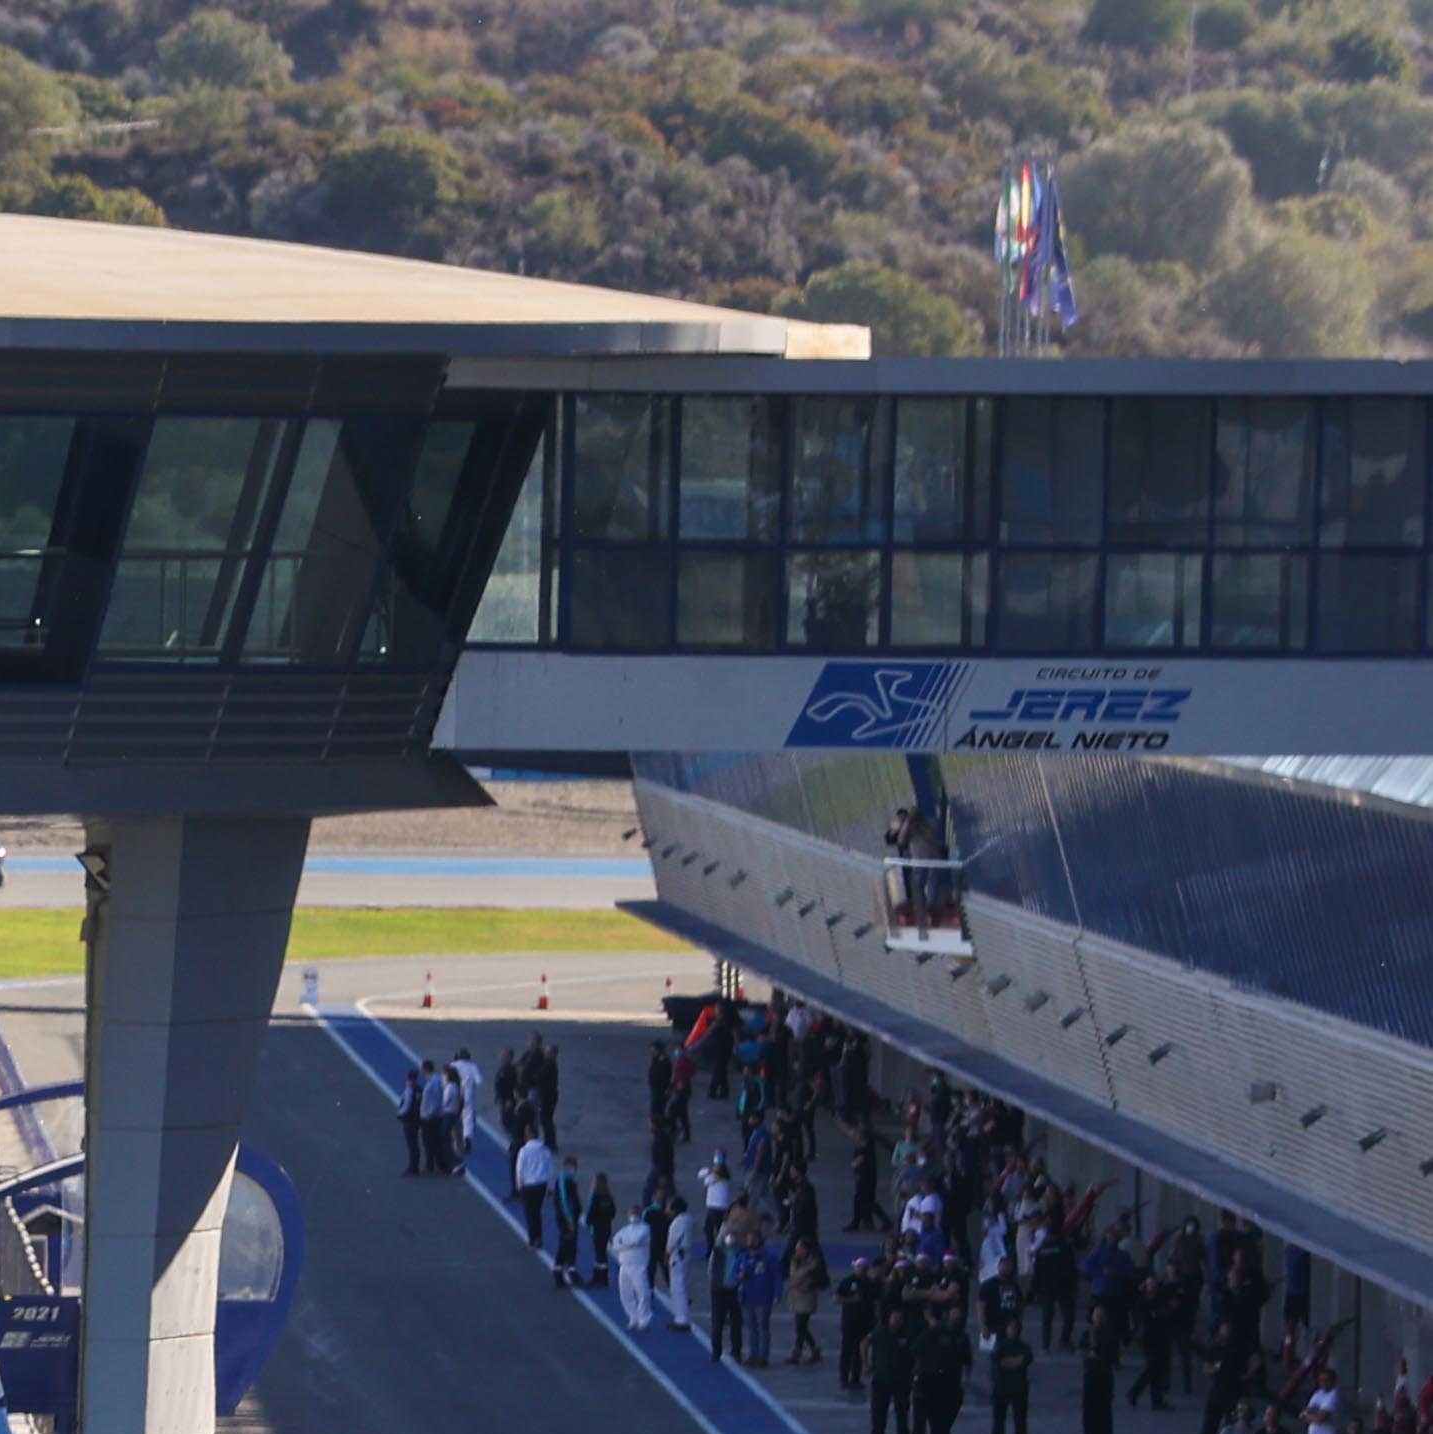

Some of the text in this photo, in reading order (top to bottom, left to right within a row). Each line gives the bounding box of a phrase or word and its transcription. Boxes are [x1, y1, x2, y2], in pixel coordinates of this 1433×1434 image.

[1036, 667, 1164, 681] CIRCUITO DE
[969, 688, 1193, 722] JEREZ
[953, 724, 1171, 751] ÁNGEL NIETO
[12, 1305, 60, 1321] 2021
